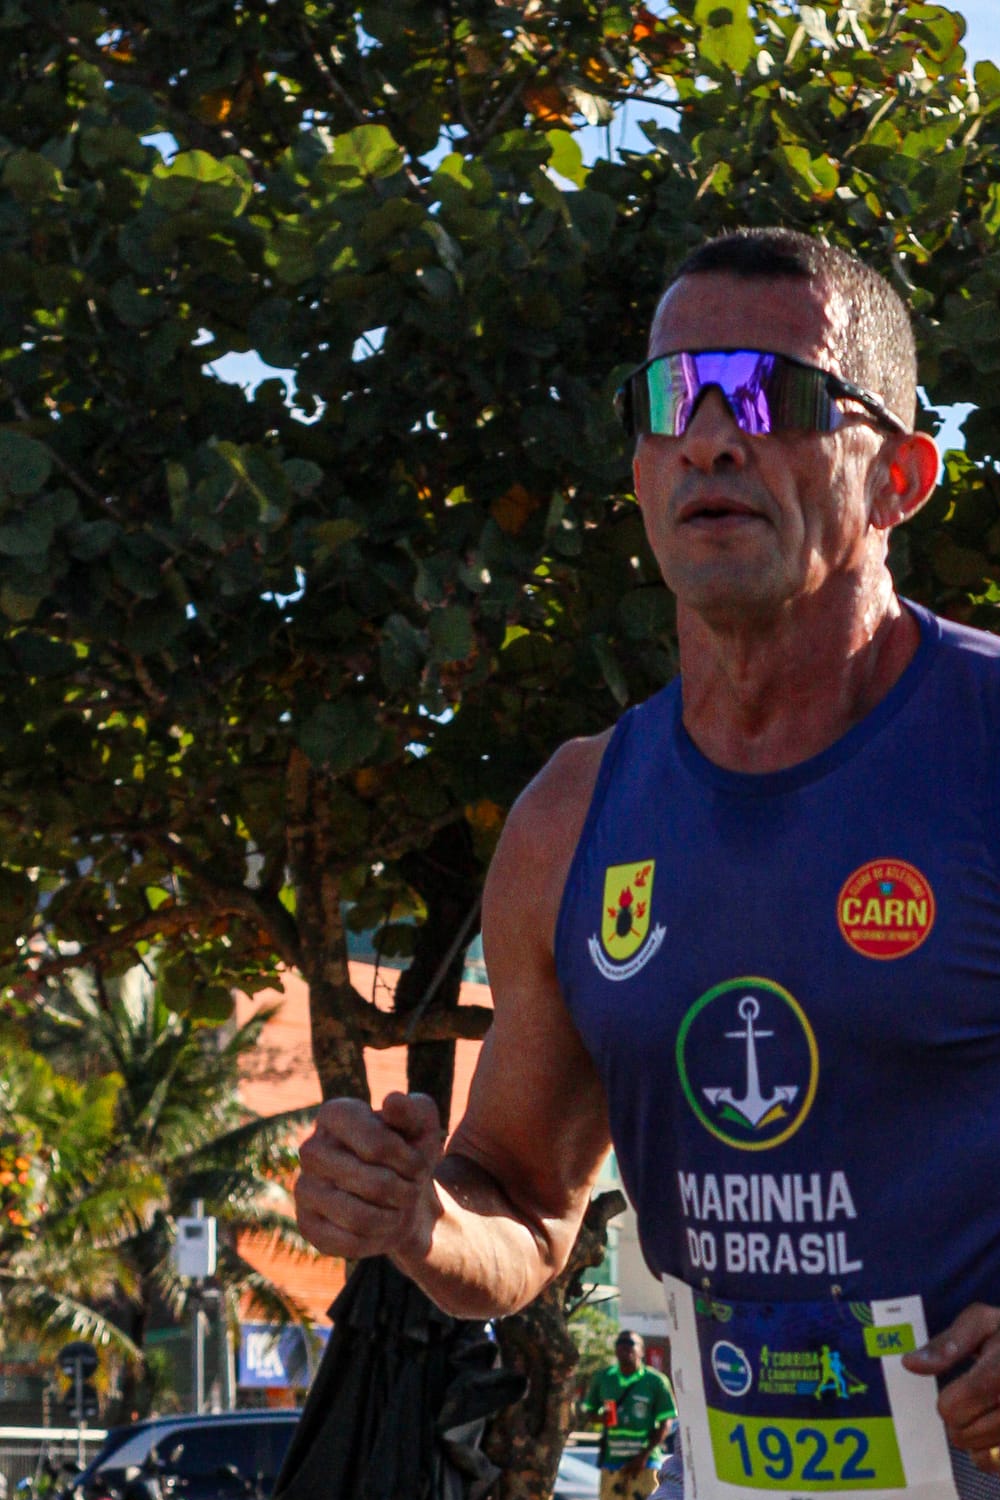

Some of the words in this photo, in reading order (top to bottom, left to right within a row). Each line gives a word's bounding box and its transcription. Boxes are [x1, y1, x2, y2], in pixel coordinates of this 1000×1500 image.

[843, 897, 928, 926] CARN
[678, 1170, 857, 1222] MARINHA
[686, 1227, 717, 1271] DO
[724, 1231, 863, 1275] BRASIL
[876, 1331, 902, 1349] 5K
[729, 1423, 876, 1481] 1922
